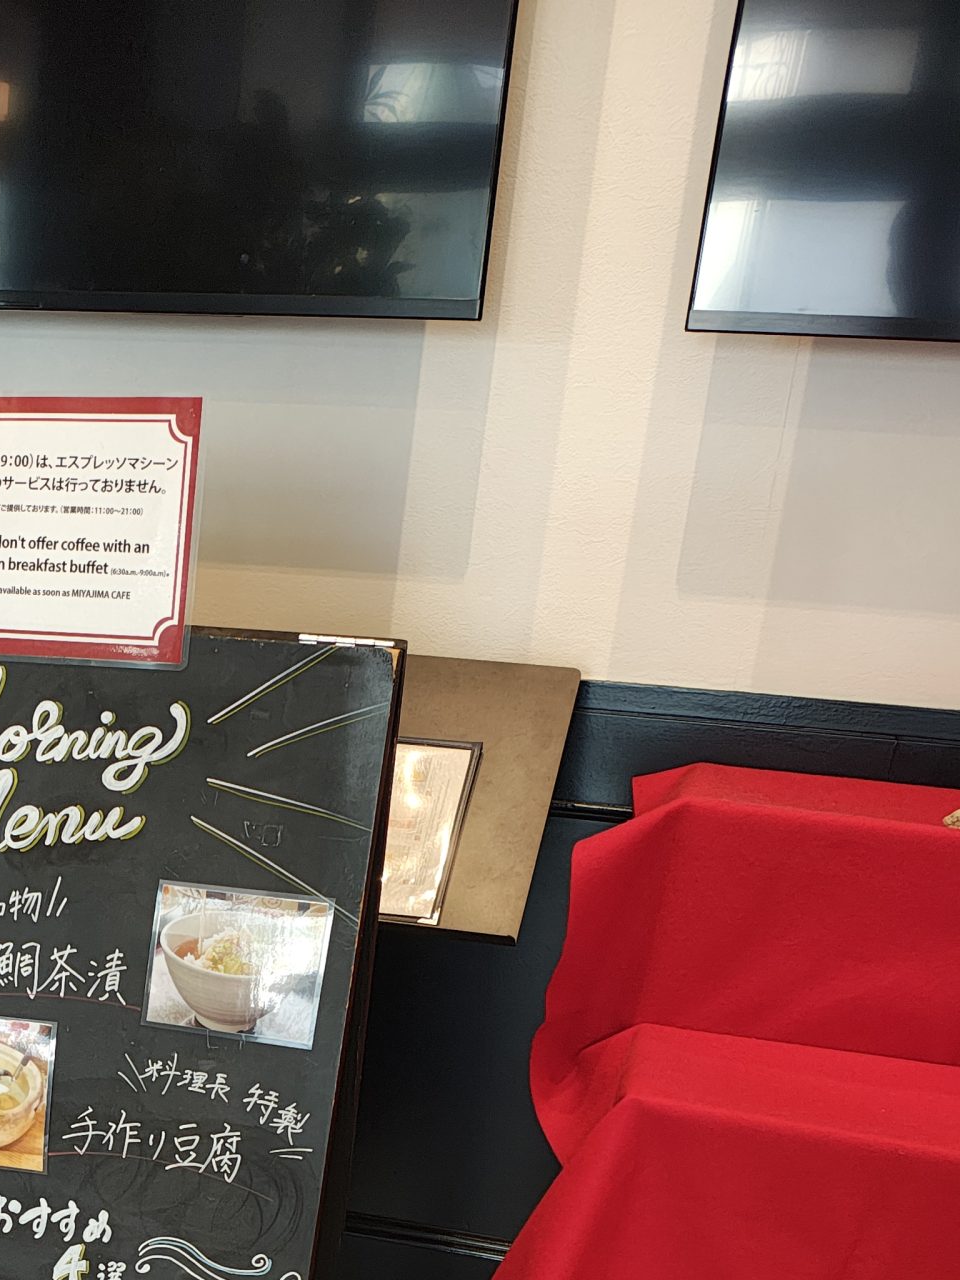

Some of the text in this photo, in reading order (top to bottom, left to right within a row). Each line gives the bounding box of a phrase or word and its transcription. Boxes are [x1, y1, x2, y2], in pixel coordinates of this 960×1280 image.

[28, 536, 59, 550] offer
[61, 537, 100, 552] coffee
[103, 539, 131, 554] with
[134, 543, 150, 554] an
[8, 557, 68, 573] breakfast
[70, 559, 109, 574] buffet
[32, 588, 41, 596] as
[42, 589, 61, 597] soon
[71, 589, 110, 599] MIYAJIMA
[111, 590, 131, 600] CAFE
[62, 1106, 242, 1184] 手作り豆腐
